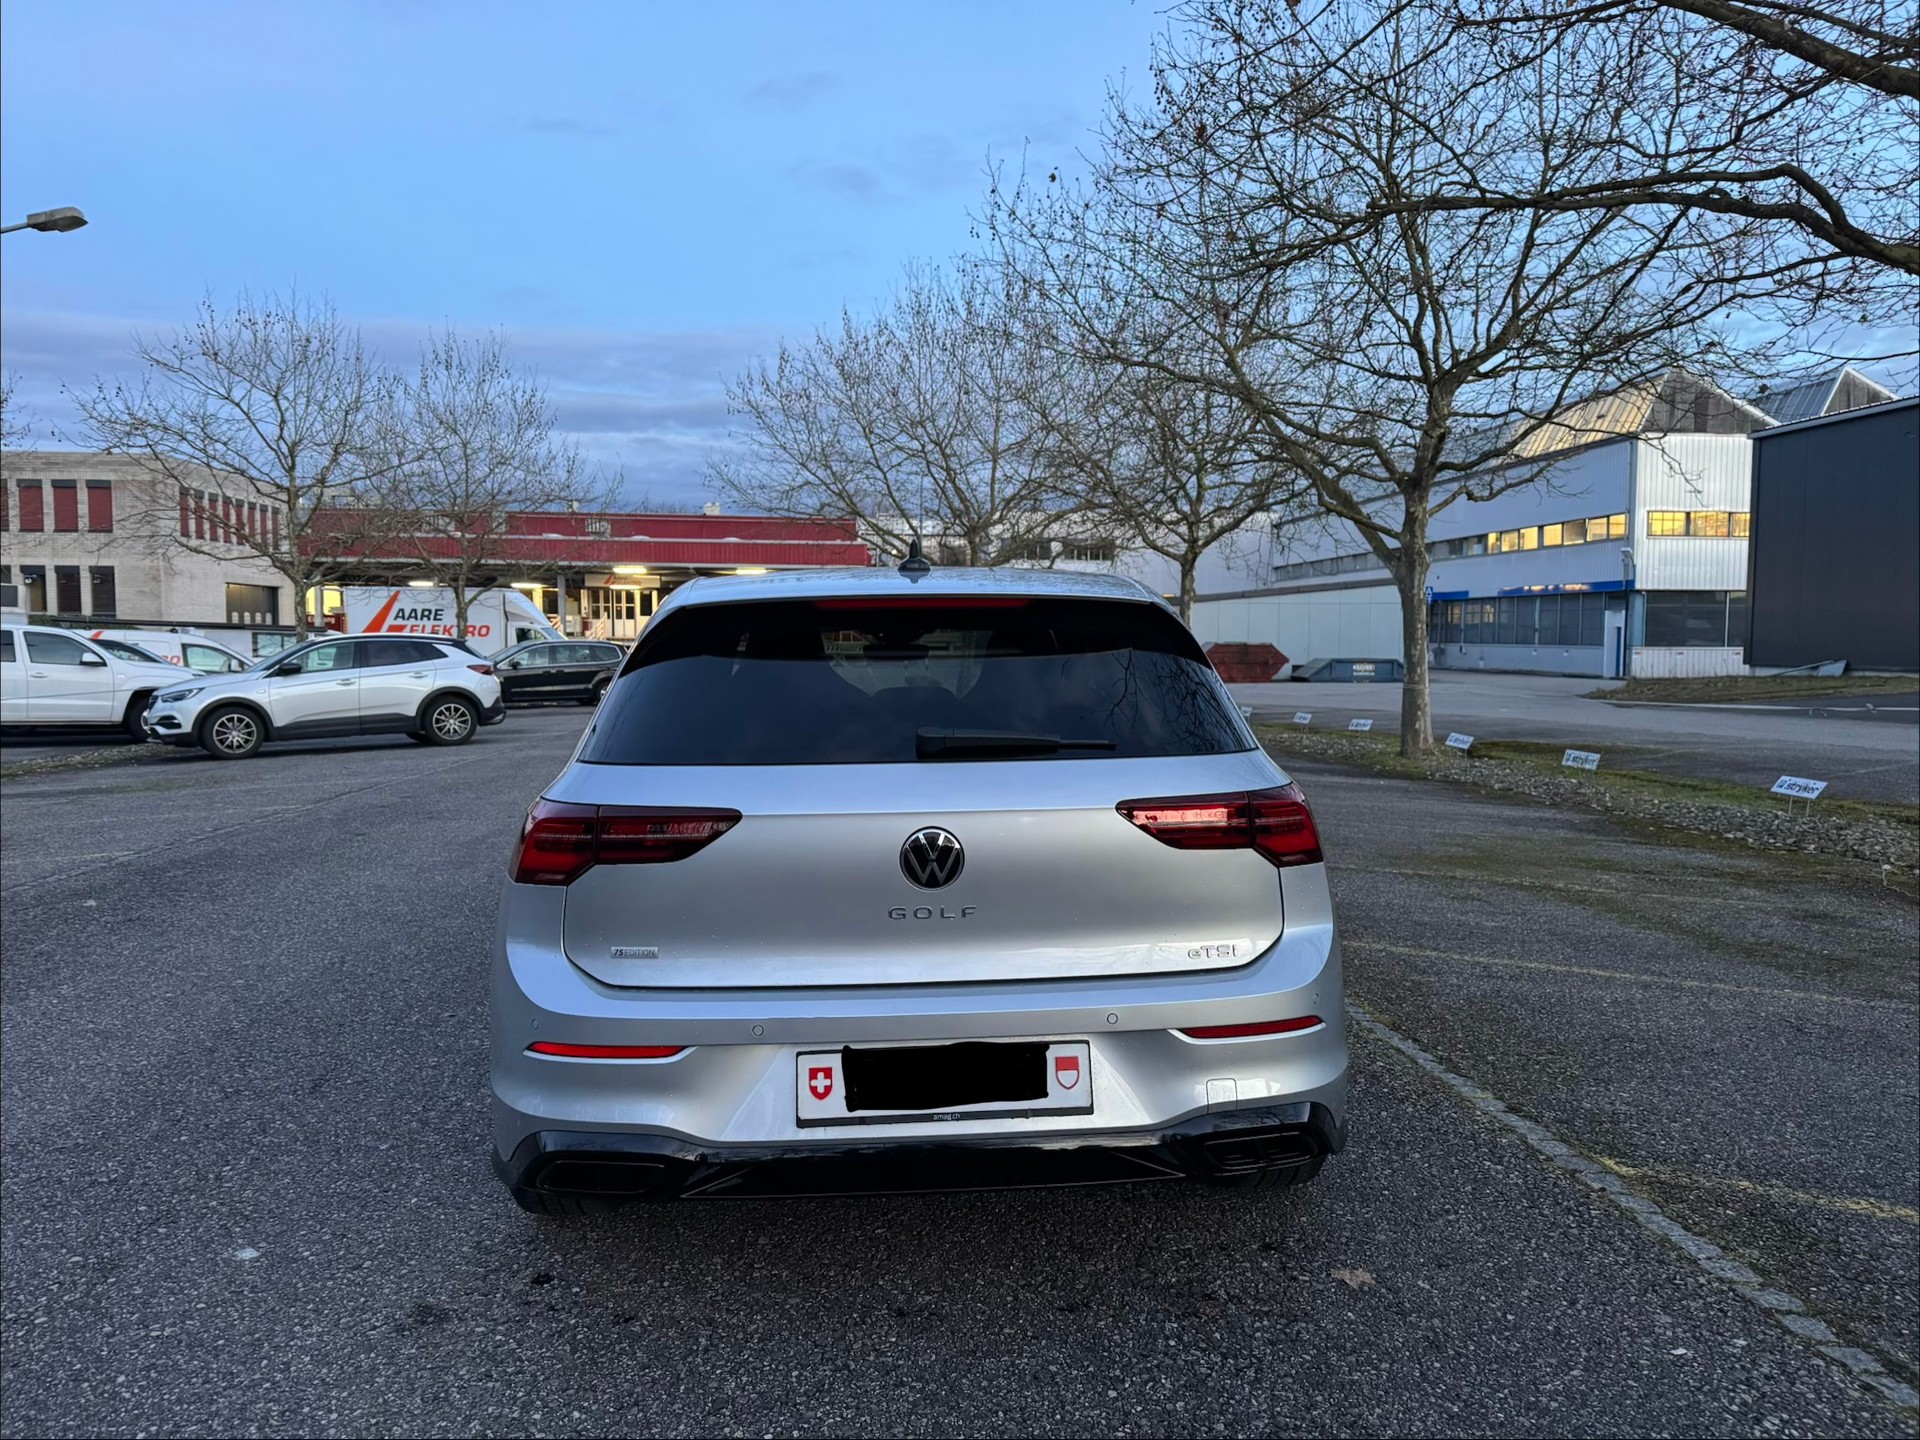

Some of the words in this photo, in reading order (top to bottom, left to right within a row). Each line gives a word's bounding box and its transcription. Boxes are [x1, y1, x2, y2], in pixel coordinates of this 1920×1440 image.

[394, 608, 445, 621] AARE
[409, 624, 491, 638] ELEKRO
[1784, 782, 1820, 794] stryker
[902, 829, 962, 889] VW
[888, 905, 977, 920] GOLF
[1188, 944, 1236, 960] eTSI
[933, 1113, 961, 1121] amag.ch
